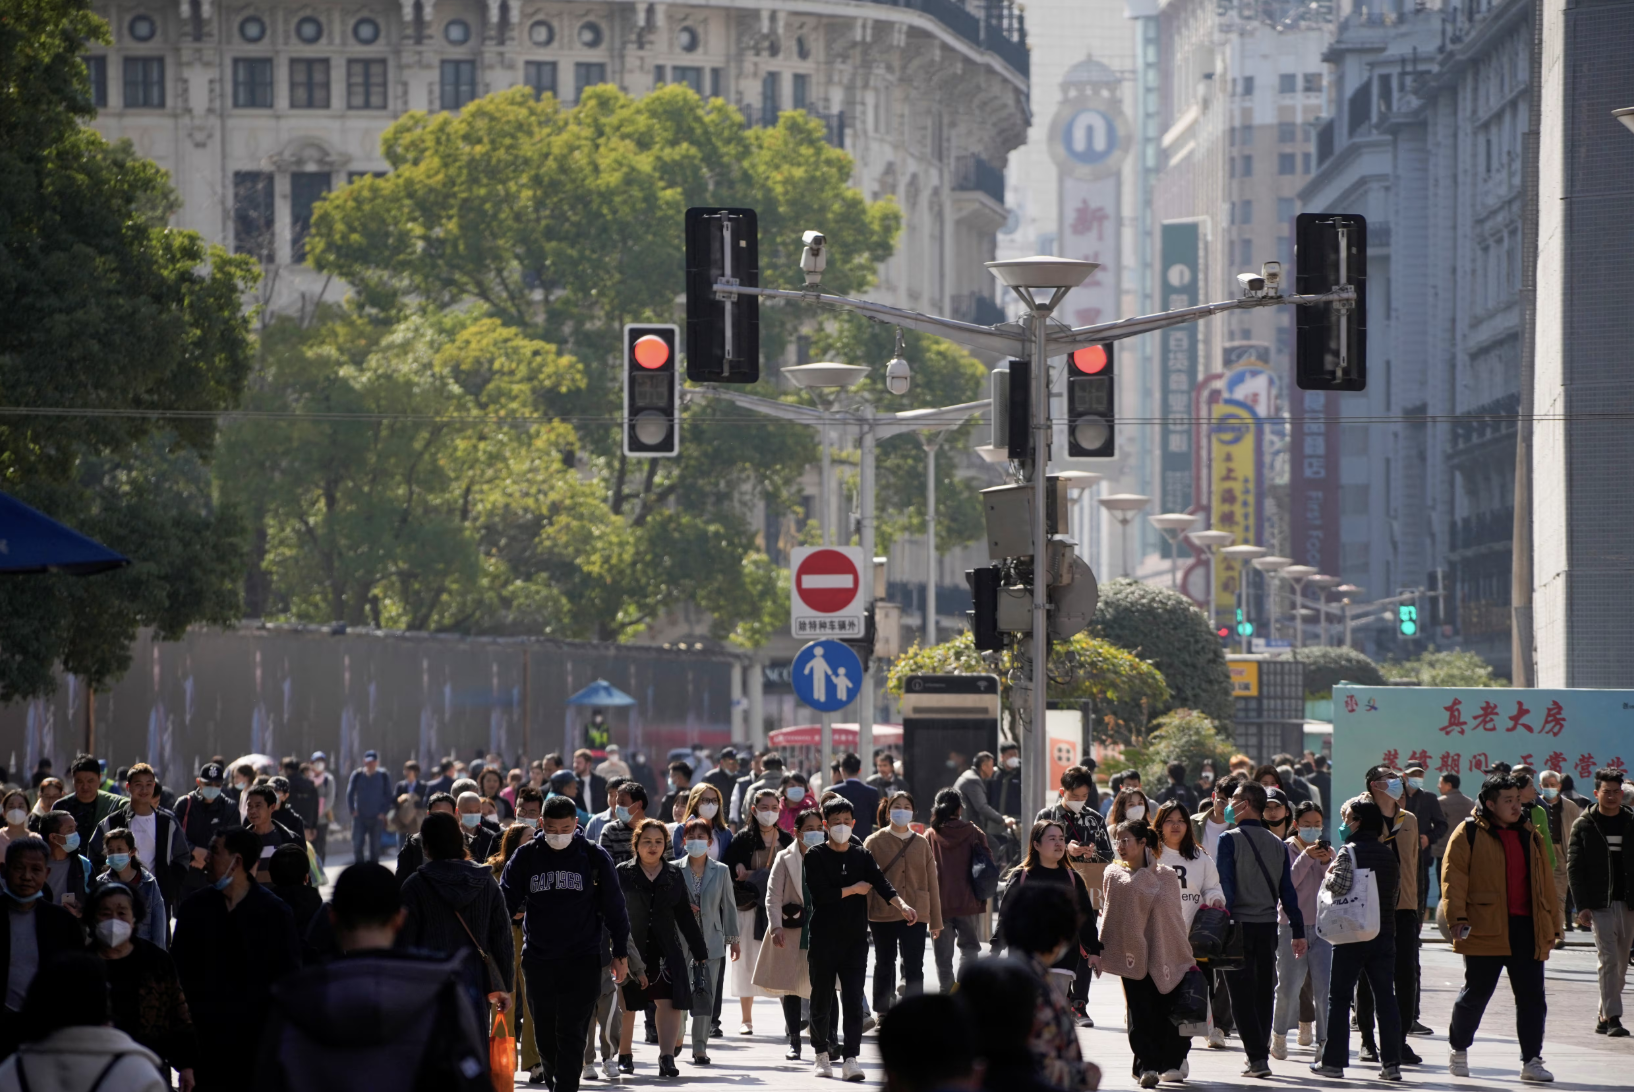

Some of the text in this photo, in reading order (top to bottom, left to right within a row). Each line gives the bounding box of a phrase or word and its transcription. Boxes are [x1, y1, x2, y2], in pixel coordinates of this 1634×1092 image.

[798, 619, 857, 632] 除特种车辆外
[1439, 697, 1568, 737] 真老大房
[530, 870, 583, 893] GAP 1969
